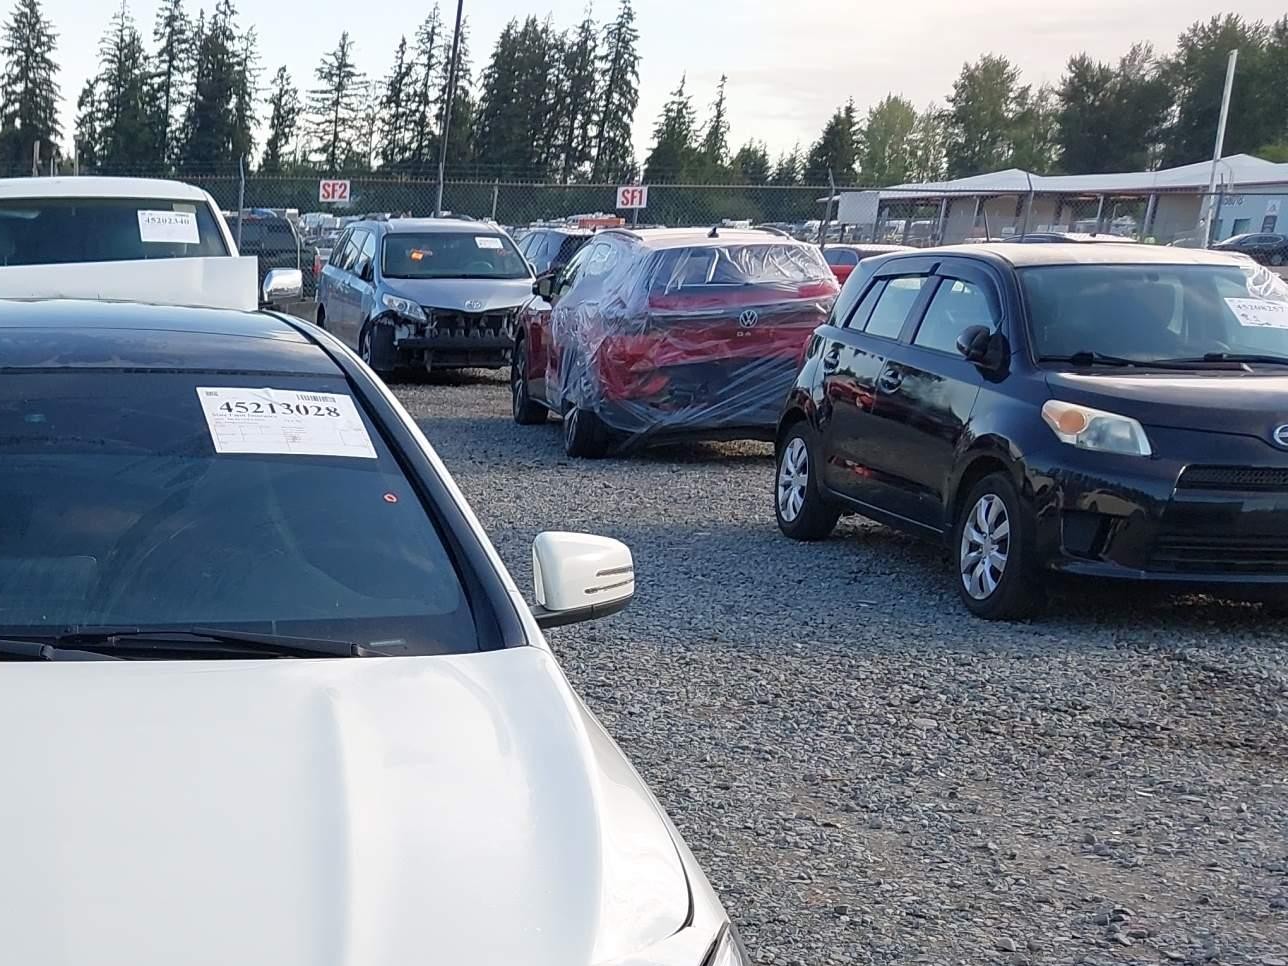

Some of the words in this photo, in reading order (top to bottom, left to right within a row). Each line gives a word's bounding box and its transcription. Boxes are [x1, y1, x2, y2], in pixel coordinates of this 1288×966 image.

[322, 182, 347, 200] SF2
[621, 188, 643, 206] SF1
[219, 401, 341, 418] 45213028
